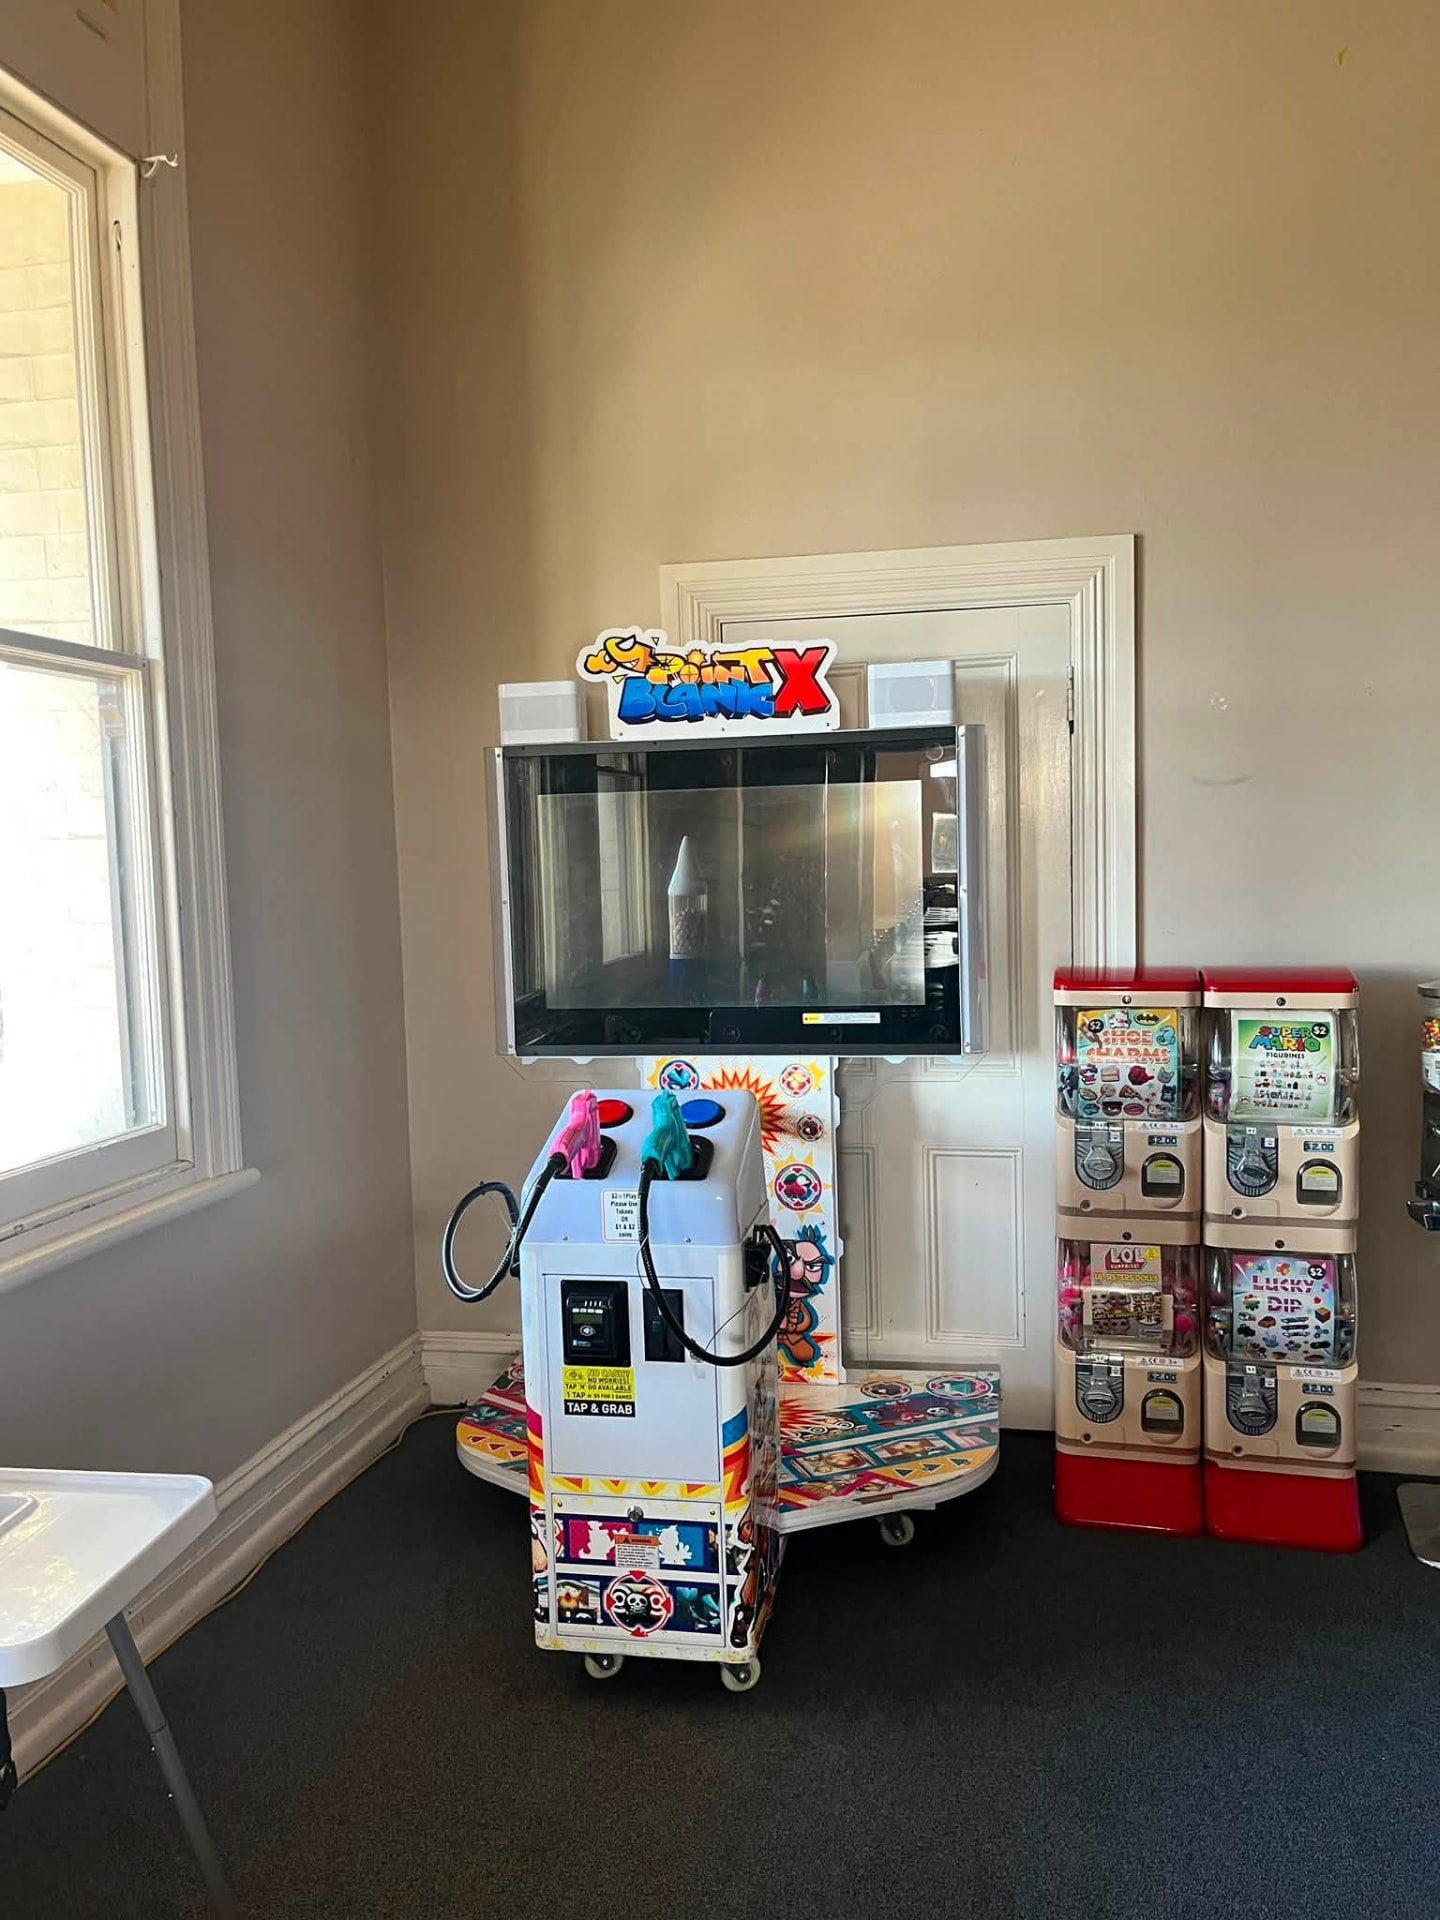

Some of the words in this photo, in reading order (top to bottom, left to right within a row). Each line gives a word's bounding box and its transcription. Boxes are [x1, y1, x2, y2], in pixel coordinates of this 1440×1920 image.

[1089, 1021, 1102, 1031] $2
[1313, 1025, 1327, 1035] $2
[1258, 1025, 1312, 1038] SUPER
[1102, 1029, 1152, 1046] SHOE
[1248, 1034, 1321, 1052] MARIO
[1265, 1051, 1305, 1059] FIGURINES
[1304, 1142, 1335, 1151] $2.00
[1310, 1267, 1324, 1277] $2
[1252, 1275, 1315, 1294] LUCKY
[1267, 1297, 1303, 1314] DIP
[598, 1384, 631, 1392] AVAILABLE
[1303, 1383, 1334, 1394] $2.00
[572, 1391, 586, 1399] TAP
[567, 1402, 588, 1413] TAP
[591, 1403, 599, 1413] &
[602, 1404, 633, 1414] GRAB
